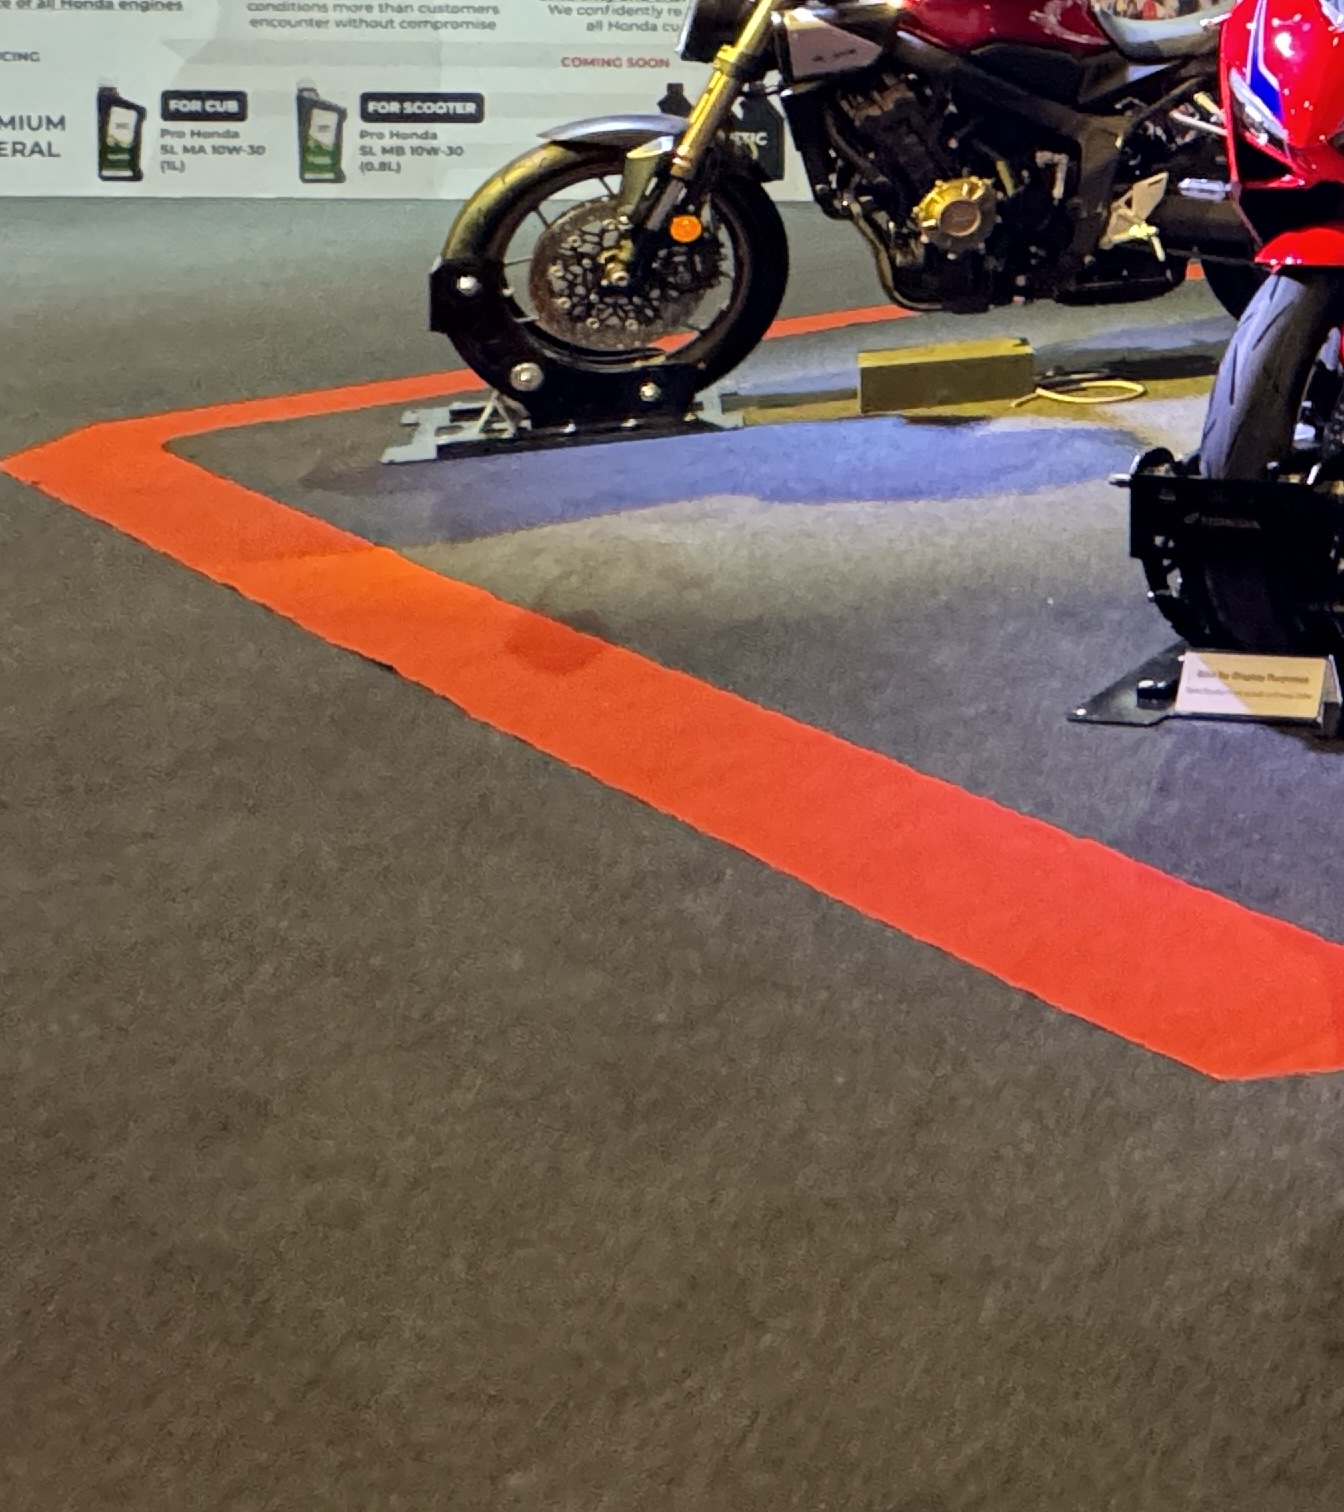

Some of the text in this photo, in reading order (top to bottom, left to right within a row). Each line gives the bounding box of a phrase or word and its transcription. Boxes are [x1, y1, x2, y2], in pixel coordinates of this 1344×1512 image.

[247, 1, 500, 15] conditions more than customers
[548, 4, 572, 16] We
[400, 19, 497, 31] compromise
[586, 21, 603, 32] all
[608, 21, 658, 33] Honda
[561, 56, 670, 69] COMING SOON
[169, 99, 202, 113] FOR
[367, 101, 477, 115] FOR SCOOTER
[160, 129, 240, 140] Pro Honda
[359, 130, 438, 141] Pro Honda
[183, 145, 207, 156] MA
